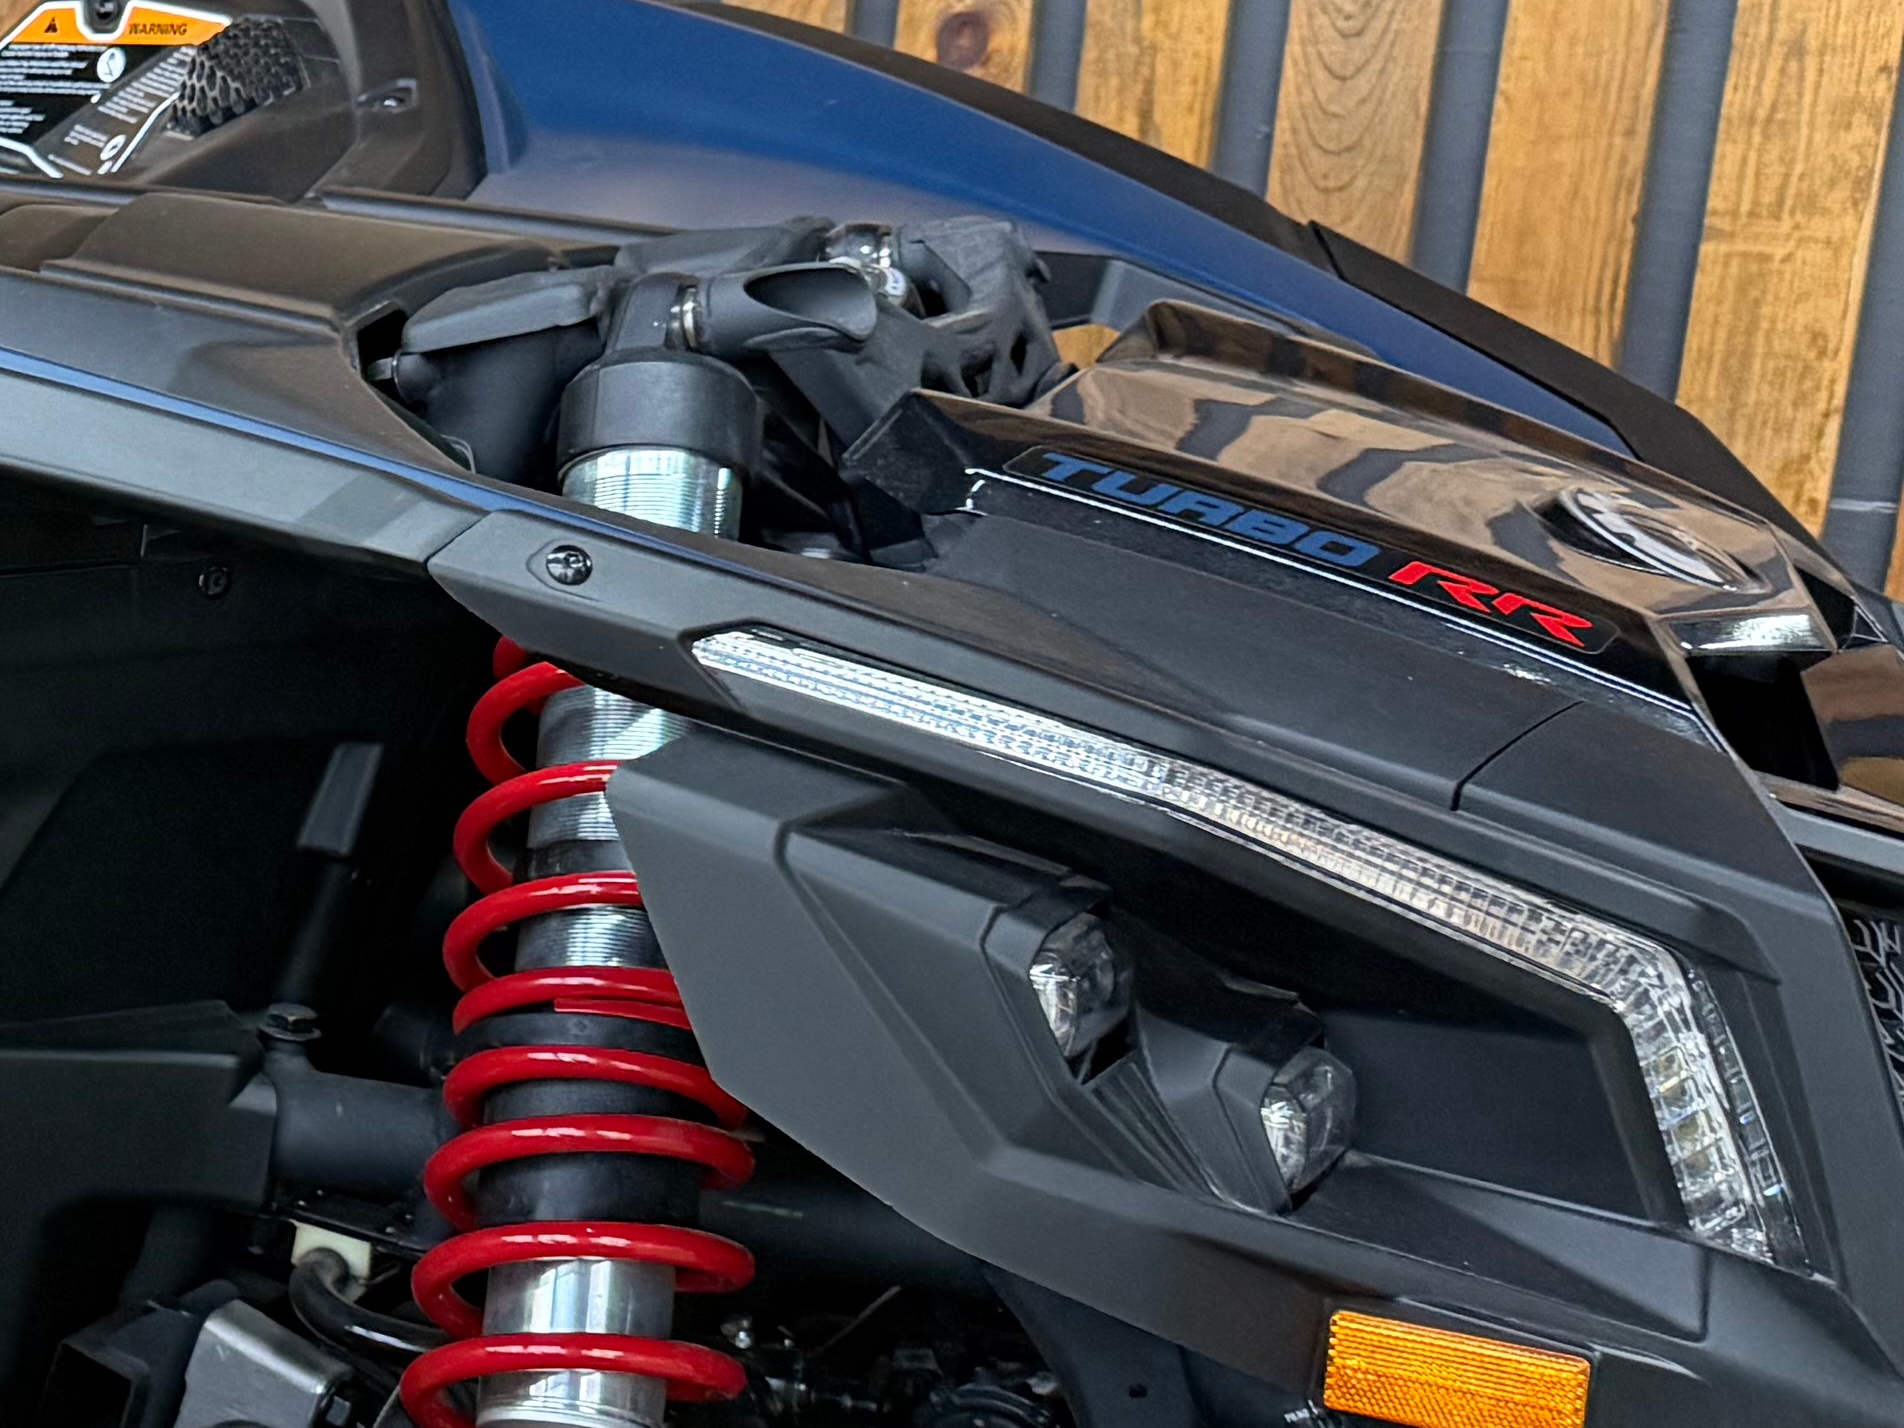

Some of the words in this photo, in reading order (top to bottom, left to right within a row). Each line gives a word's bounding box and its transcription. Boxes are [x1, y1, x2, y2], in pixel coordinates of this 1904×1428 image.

[128, 22, 188, 38] WARNING
[1040, 451, 1383, 568] TURBO
[1389, 560, 1594, 649] RR
